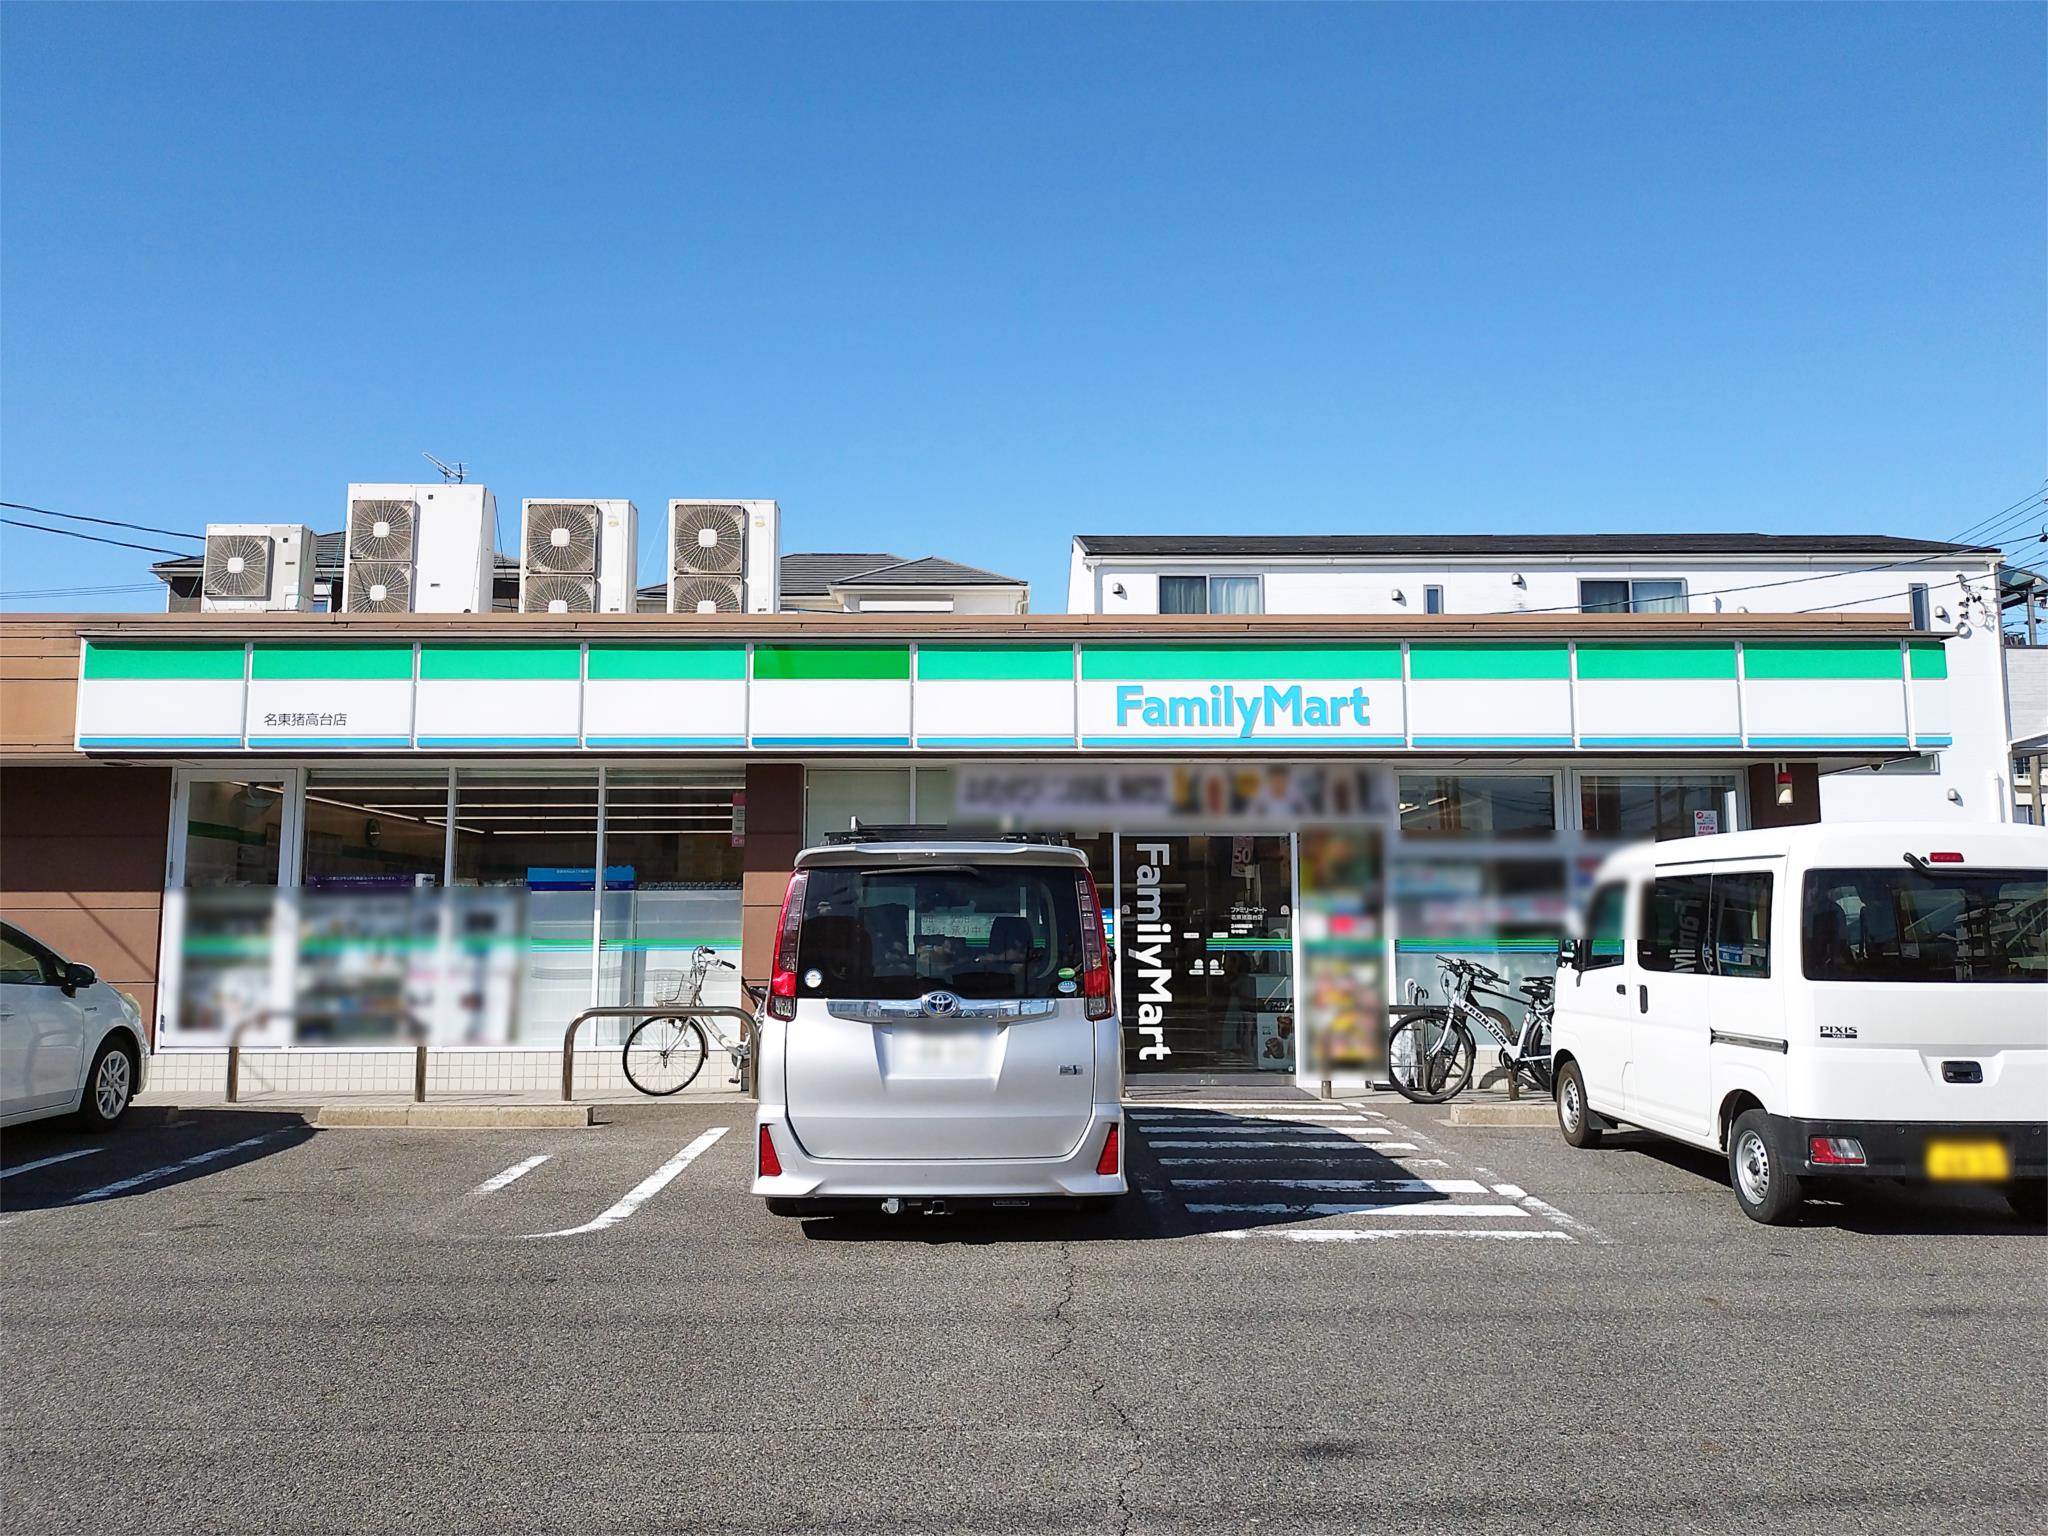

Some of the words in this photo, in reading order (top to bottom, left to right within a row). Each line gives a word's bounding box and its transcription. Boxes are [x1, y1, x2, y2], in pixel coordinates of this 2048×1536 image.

[264, 713, 347, 726] 名東猪高台店
[1117, 685, 1371, 738] FamilyMart
[1128, 843, 1173, 1061] FamilyMart
[1820, 1025, 1858, 1033] PIXIS
